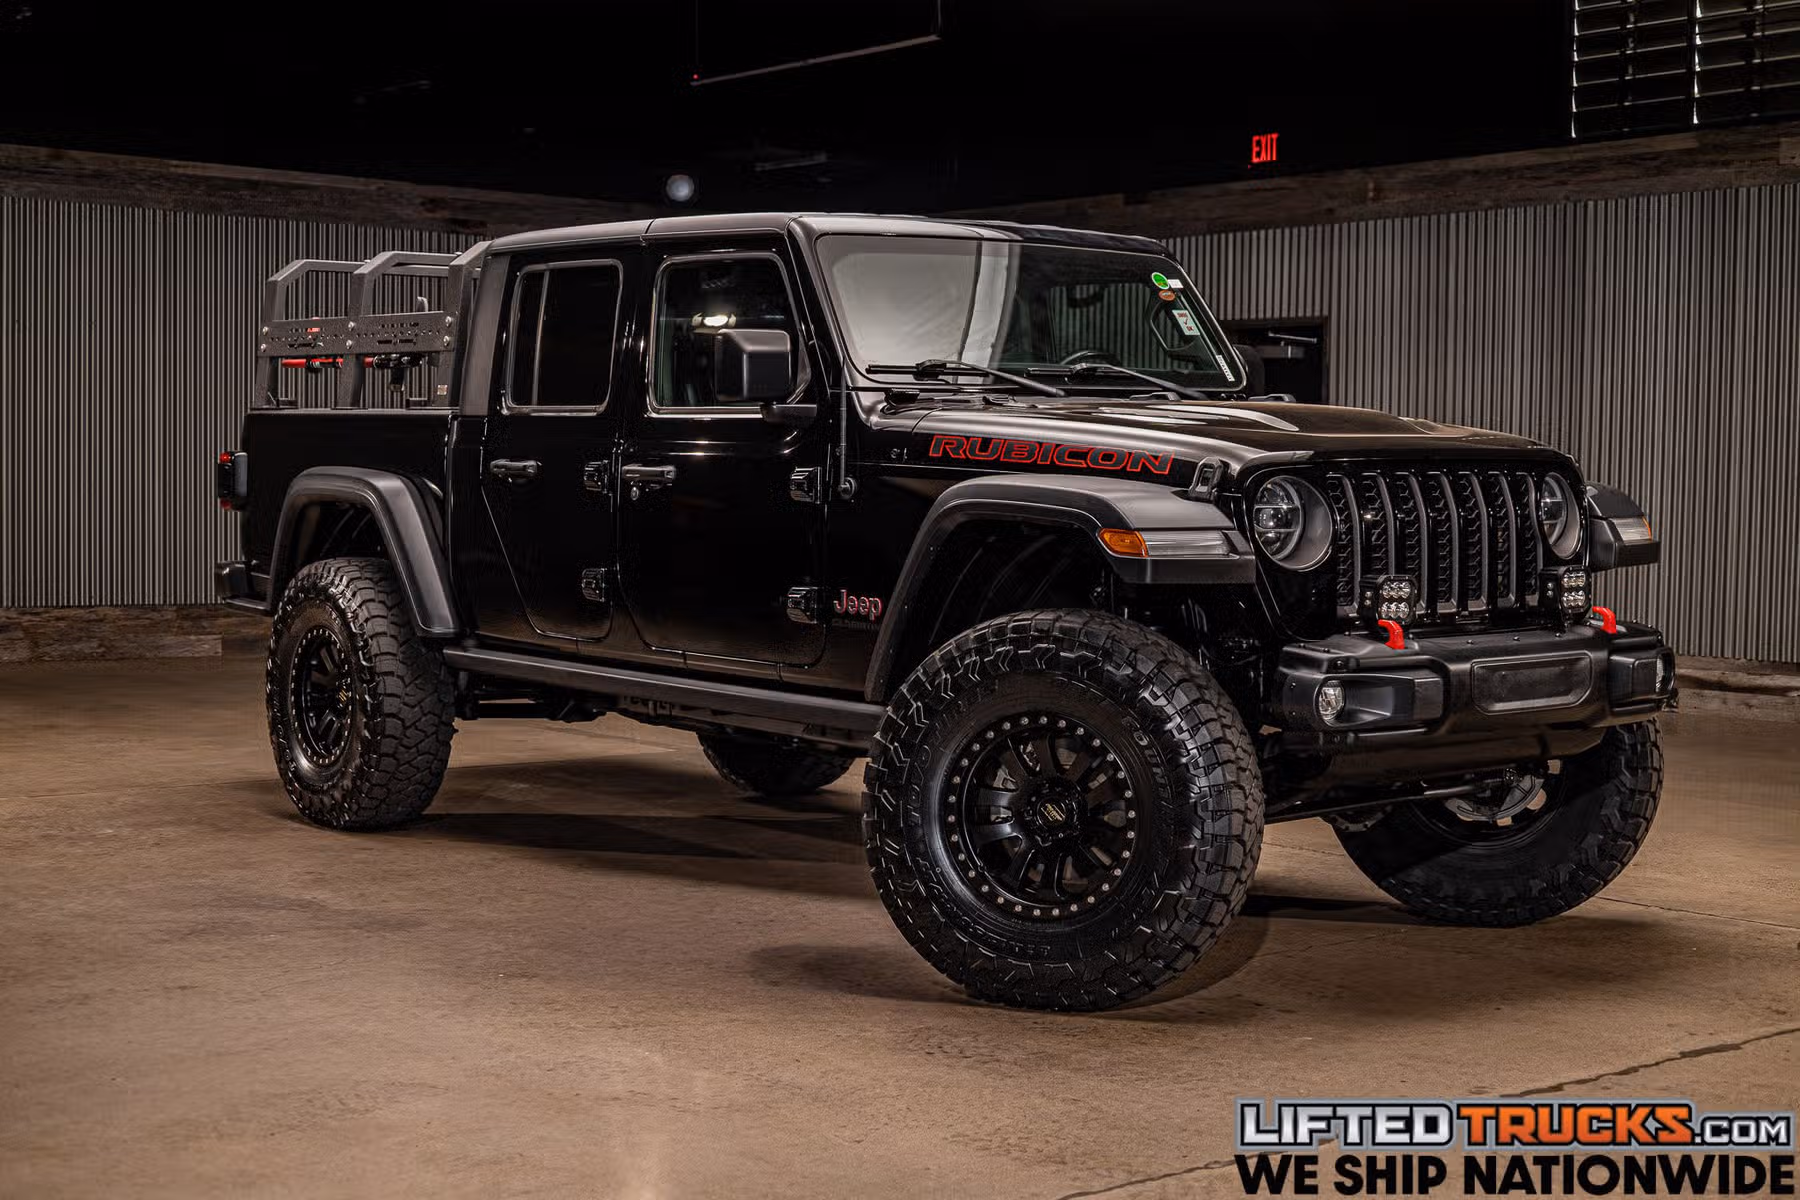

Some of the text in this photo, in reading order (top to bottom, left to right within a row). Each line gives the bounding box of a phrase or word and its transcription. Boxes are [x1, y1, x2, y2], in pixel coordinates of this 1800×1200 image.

[1251, 133, 1278, 163] EXIT
[929, 434, 1175, 475] RUBICON
[833, 589, 882, 620] Jeep
